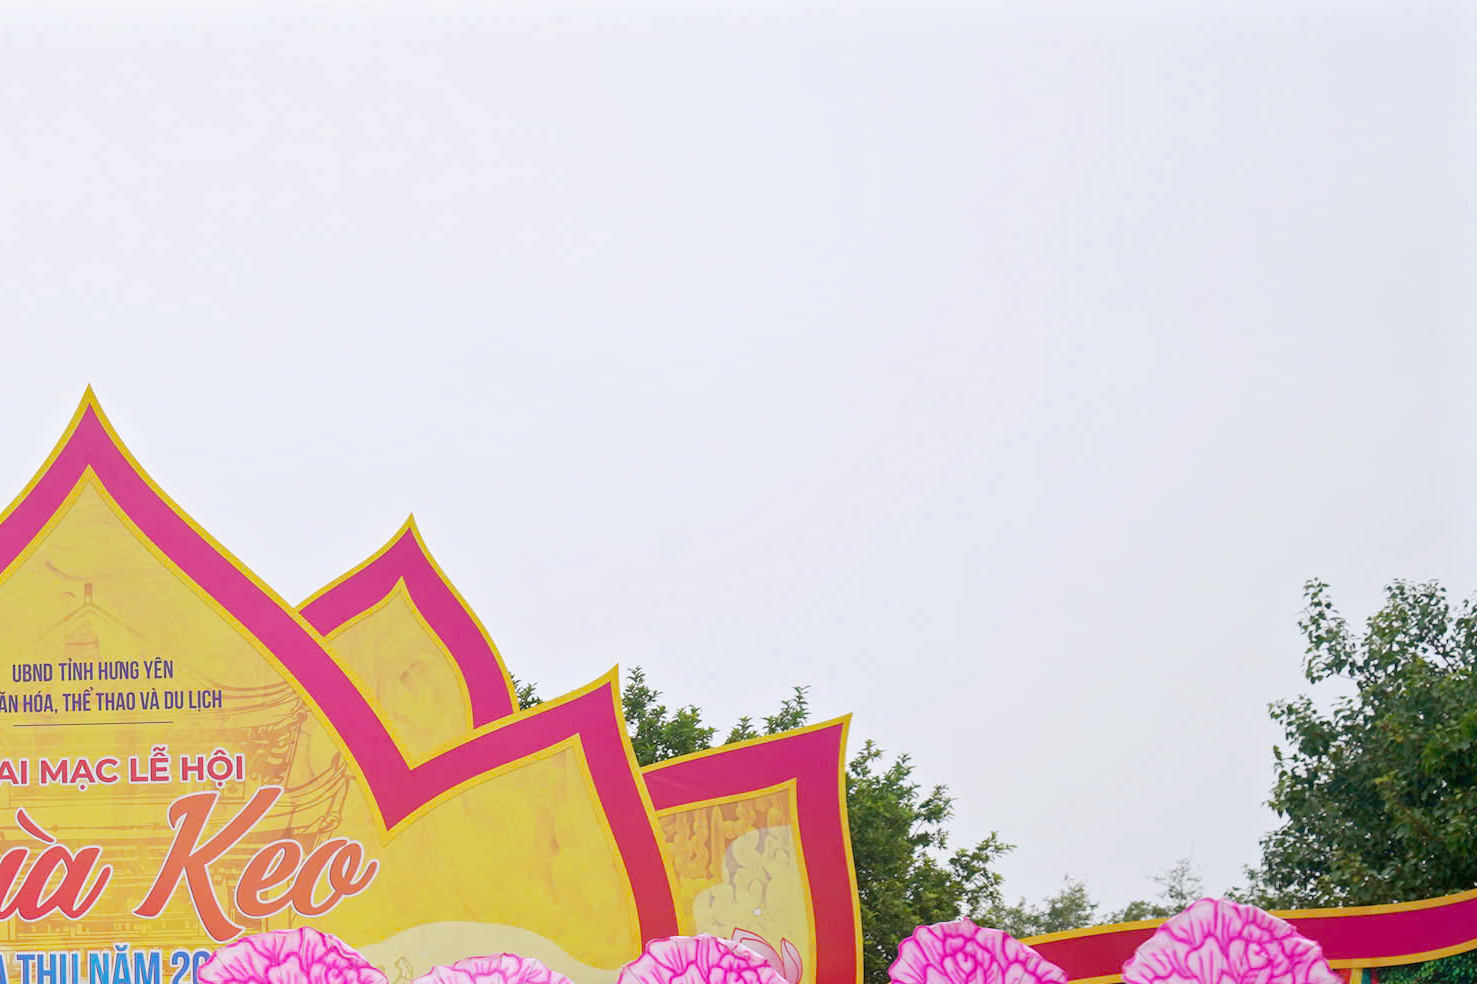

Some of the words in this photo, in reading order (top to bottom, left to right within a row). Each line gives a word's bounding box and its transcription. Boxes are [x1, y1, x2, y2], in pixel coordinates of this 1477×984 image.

[12, 662, 53, 683] UBND
[59, 658, 94, 681] TỈNH
[98, 660, 139, 681] HƯNG
[143, 656, 174, 679] YÊN
[23, 690, 58, 715] HÓA,
[62, 687, 94, 712] THỂ
[96, 692, 136, 711] THAO
[140, 690, 160, 711] VÀ
[164, 691, 184, 710] DU
[189, 689, 223, 712] LỊCH
[39, 757, 120, 792] MẠC
[129, 745, 171, 784] LỄ
[180, 748, 245, 789] HỘI
[132, 785, 380, 942] Keo
